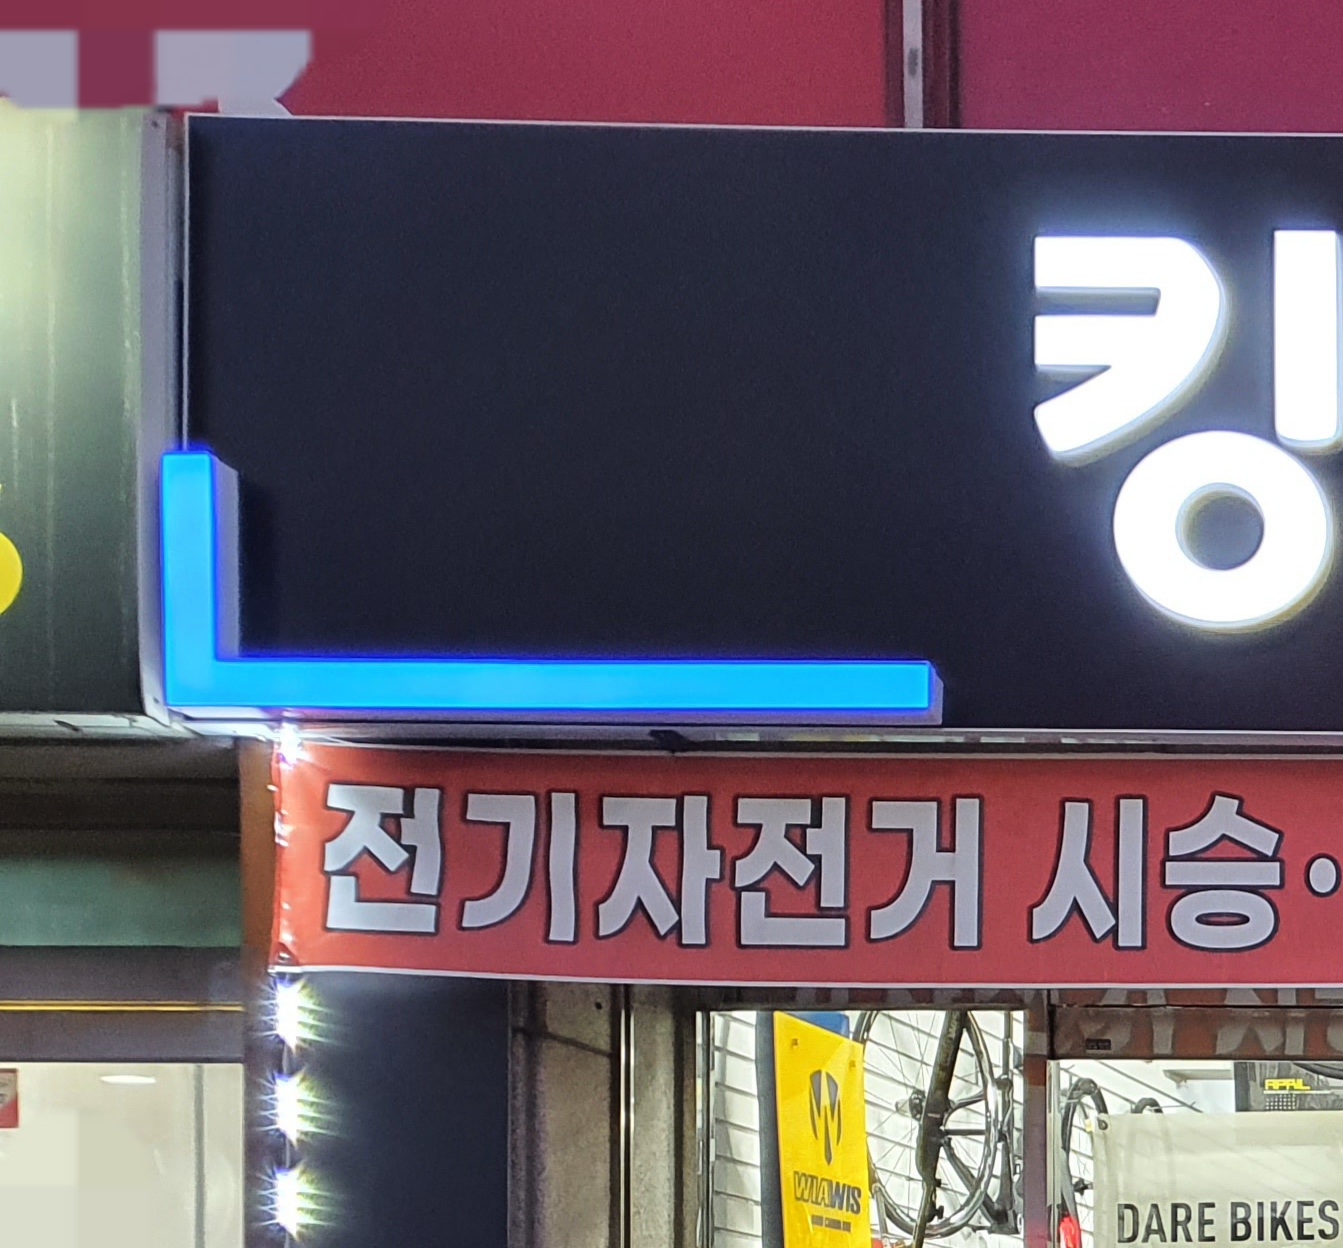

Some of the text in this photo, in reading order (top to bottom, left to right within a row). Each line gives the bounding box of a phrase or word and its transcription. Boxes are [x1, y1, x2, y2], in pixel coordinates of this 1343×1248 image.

[320, 781, 984, 950] 전기자전거
[793, 1170, 862, 1214] WIAWIS
[1116, 1200, 1341, 1244] DARE BIKES
